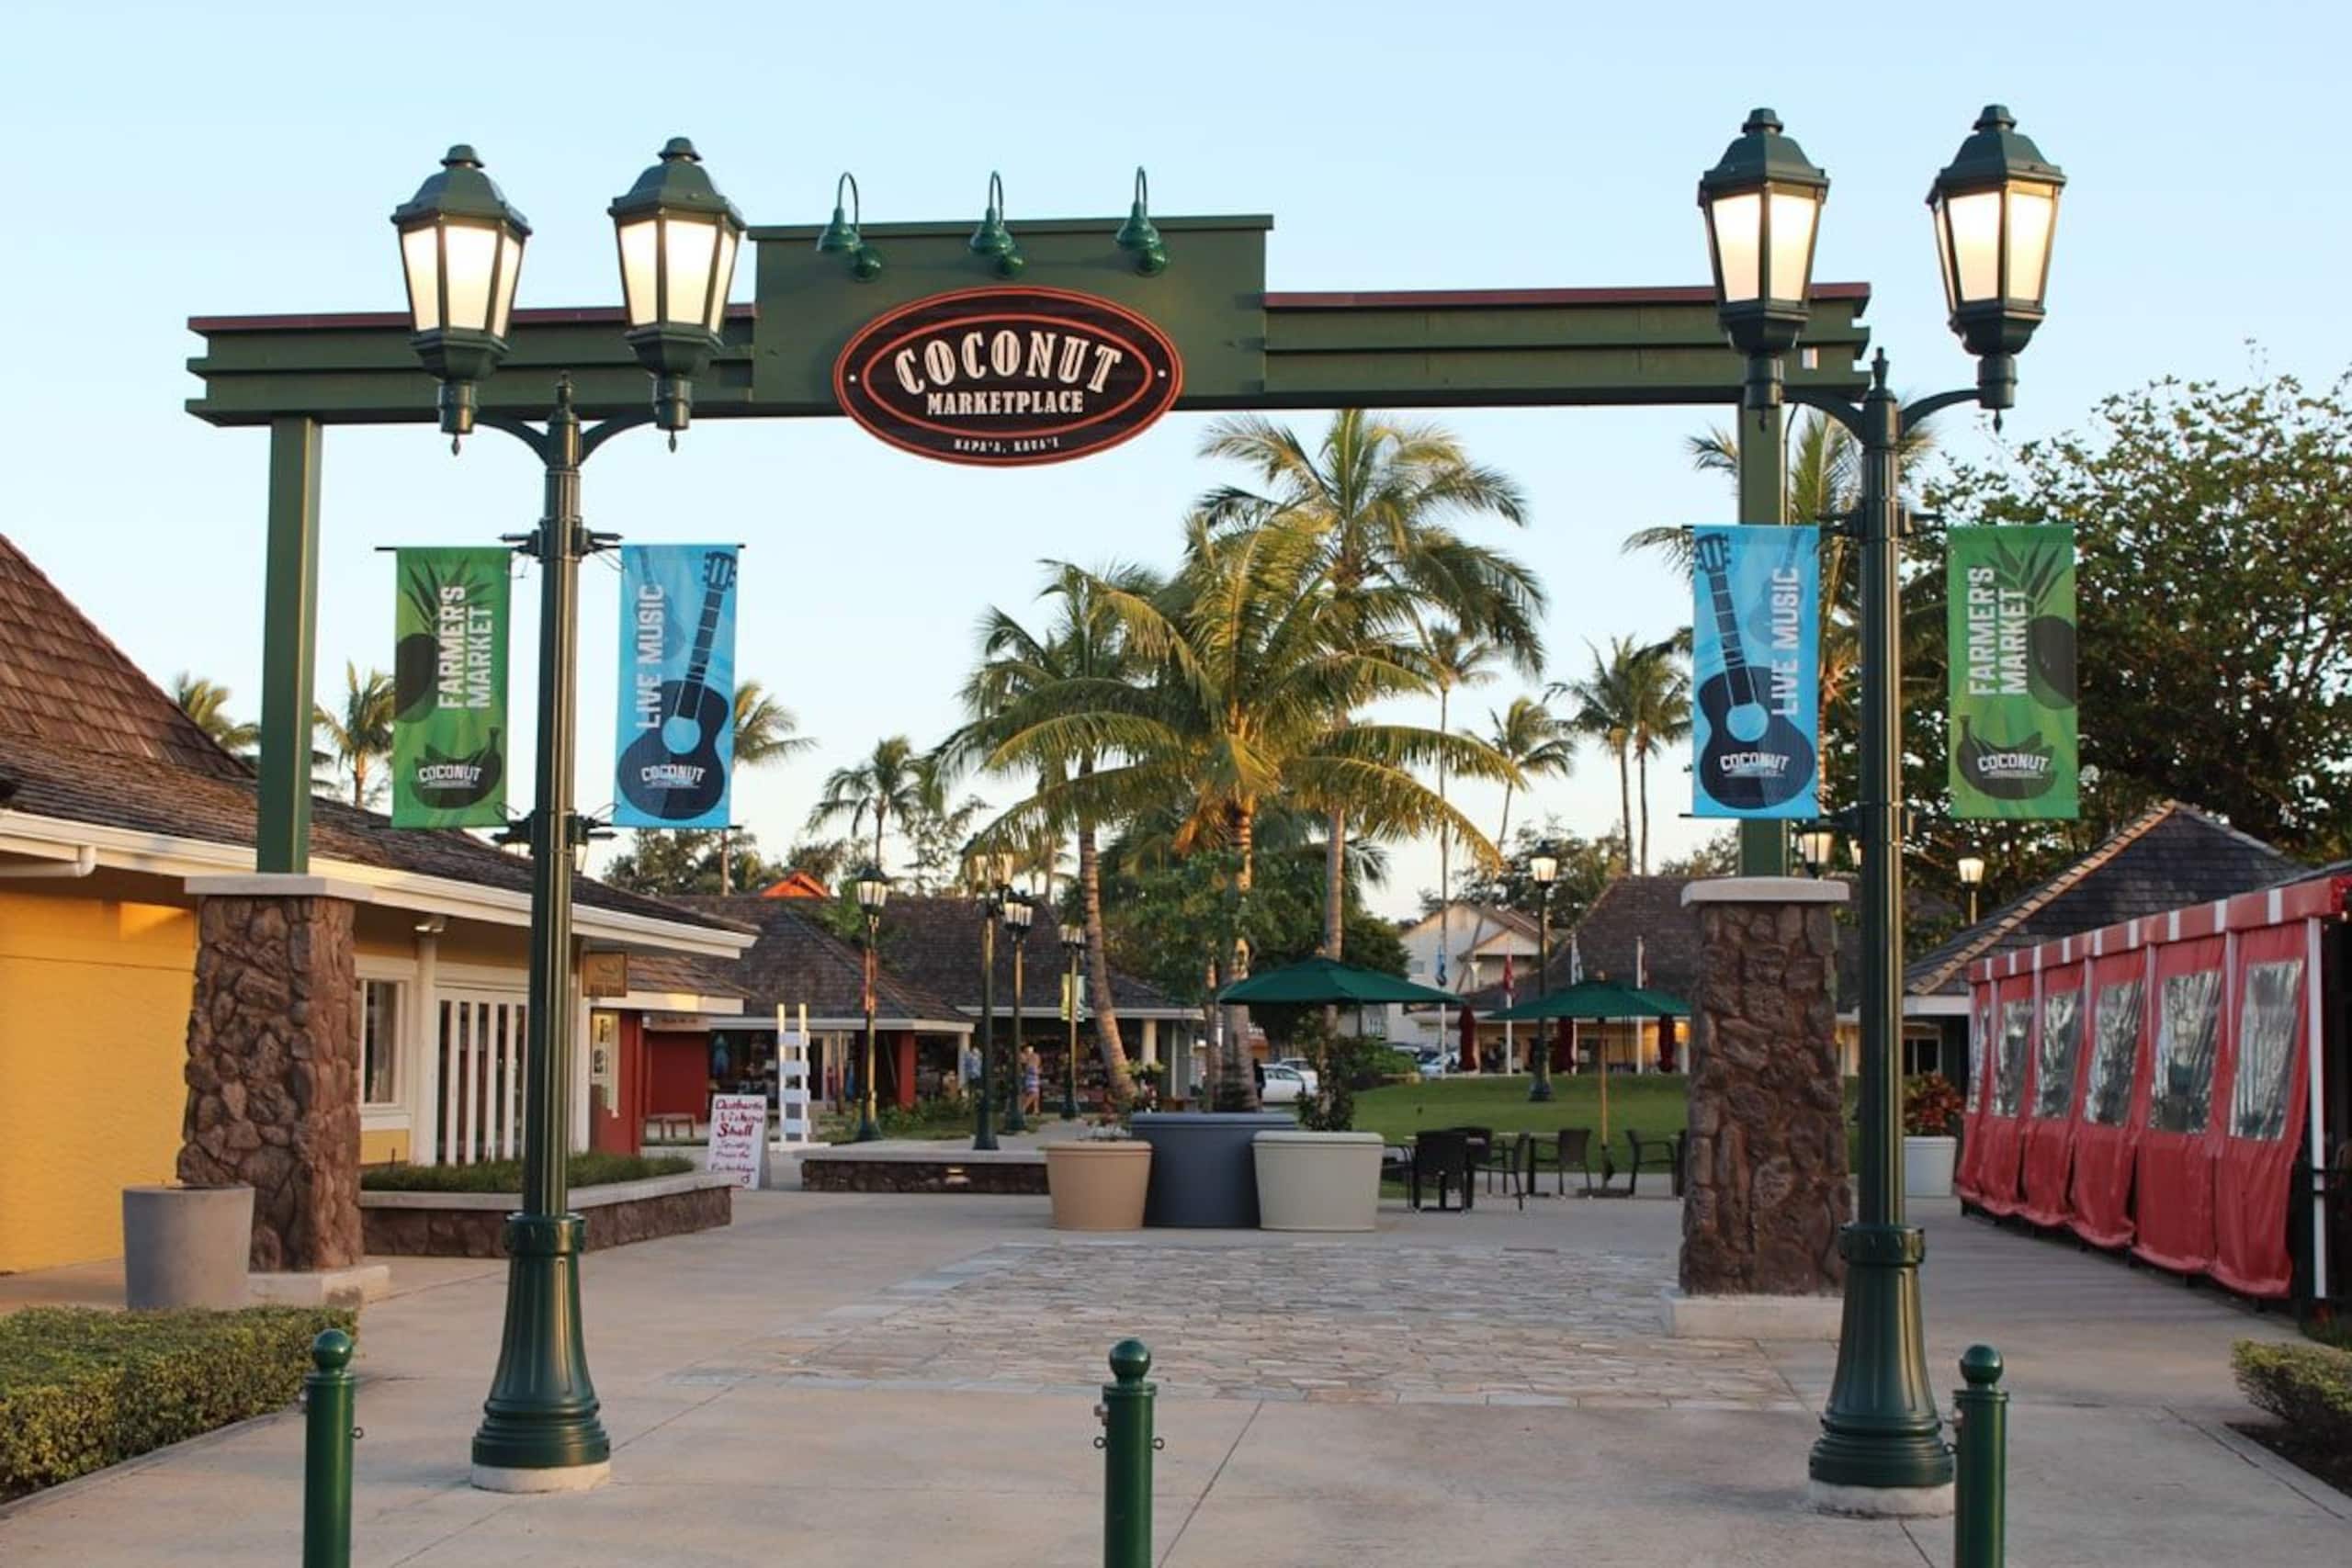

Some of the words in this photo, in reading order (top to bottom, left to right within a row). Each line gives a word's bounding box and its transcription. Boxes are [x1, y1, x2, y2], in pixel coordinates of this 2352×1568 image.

[895, 330, 1122, 395] COCONUT
[927, 390, 1083, 415] MARKETPLACE
[637, 583, 664, 666] MUSIC
[1772, 567, 1800, 650] MUSIC
[1968, 567, 1996, 696] FARMER'S
[438, 585, 466, 709] FARMER'S
[466, 606, 492, 709] MARKET
[1999, 587, 2028, 695] MARKET
[636, 673, 661, 729] LIVE
[1771, 659, 1798, 716] LIVE
[418, 764, 482, 783] COCONUT
[640, 764, 707, 783] COCONUT
[1719, 752, 1791, 772] COCONUT
[1976, 752, 2050, 772] COCONUT
